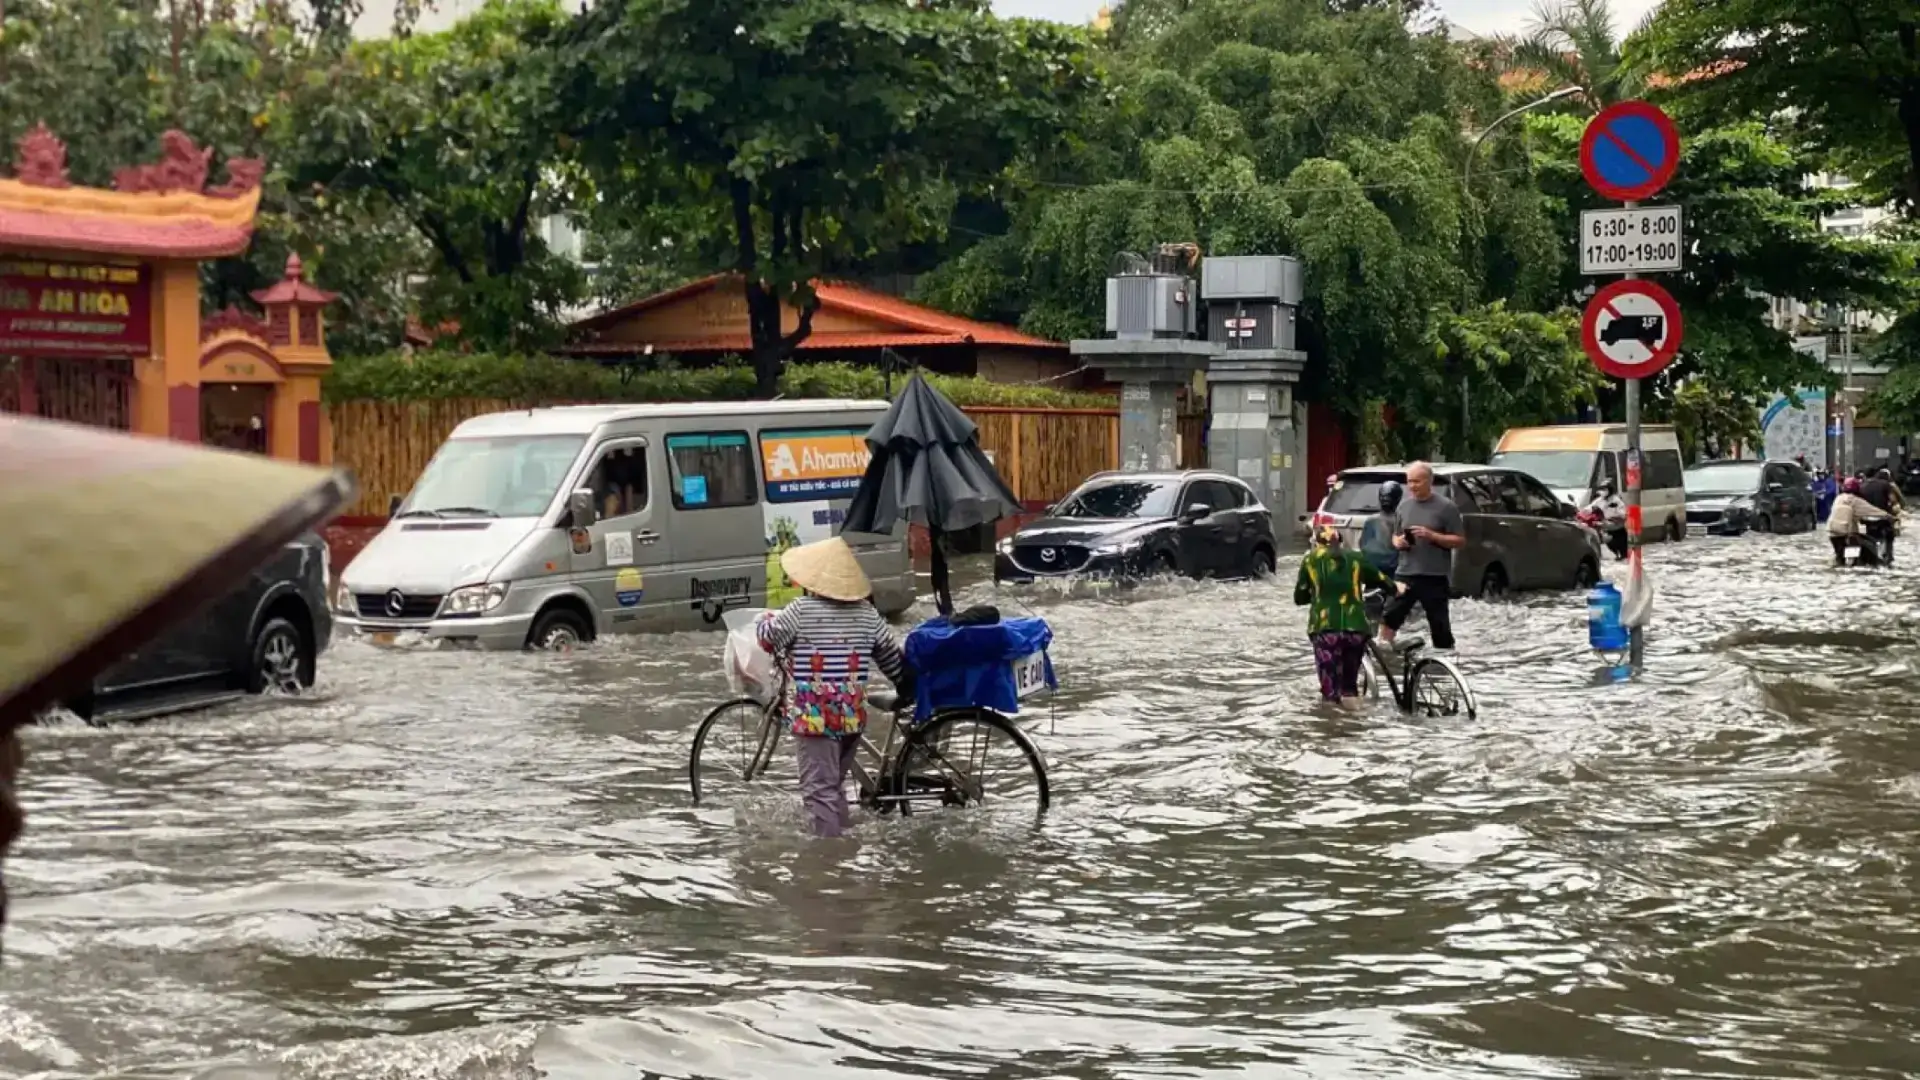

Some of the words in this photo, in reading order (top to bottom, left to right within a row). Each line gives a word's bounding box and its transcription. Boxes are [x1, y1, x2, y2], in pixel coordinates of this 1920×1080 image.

[1641, 216, 1676, 235] 8:00
[1586, 242, 1676, 263] 17:00-19:00
[39, 288, 74, 313] AN
[691, 576, 751, 599] Discovery
